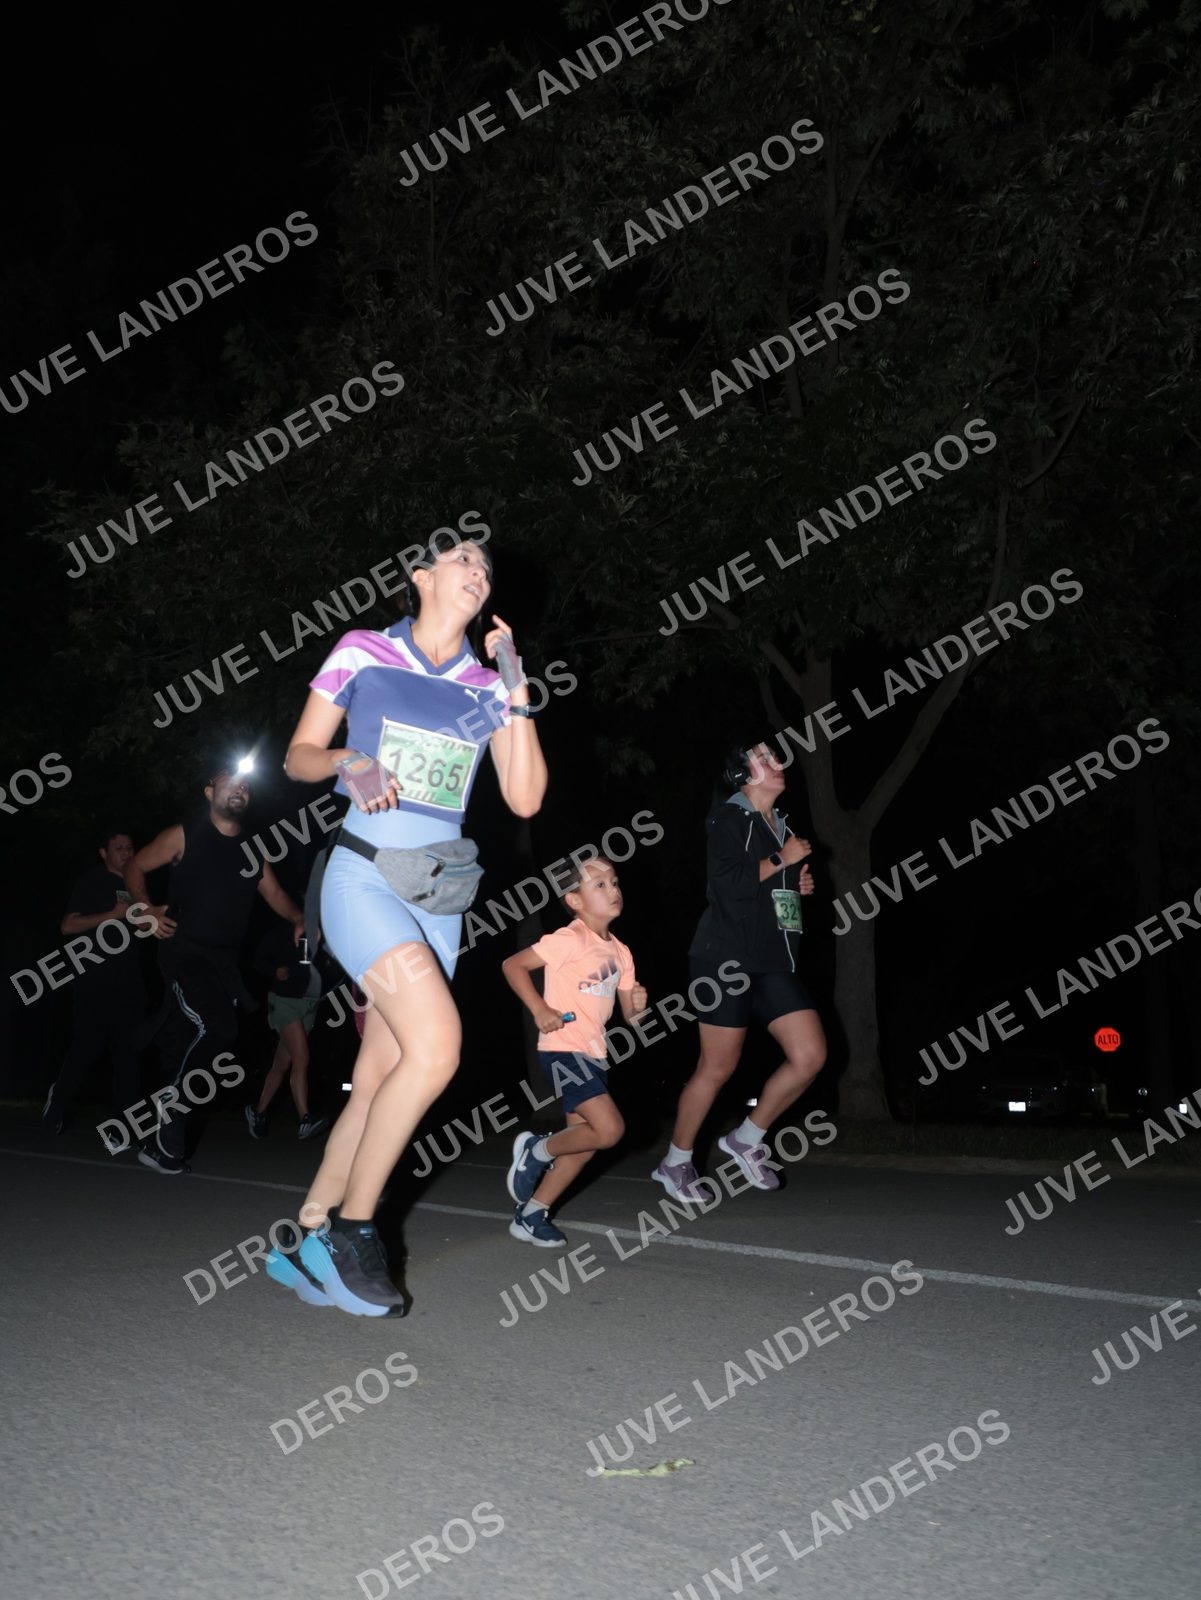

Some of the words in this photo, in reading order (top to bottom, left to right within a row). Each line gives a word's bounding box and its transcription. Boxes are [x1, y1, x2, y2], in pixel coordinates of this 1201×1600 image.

[388, 747, 464, 792] 1265
[779, 902, 801, 920] 32
[1098, 1034, 1119, 1045] ALTO
